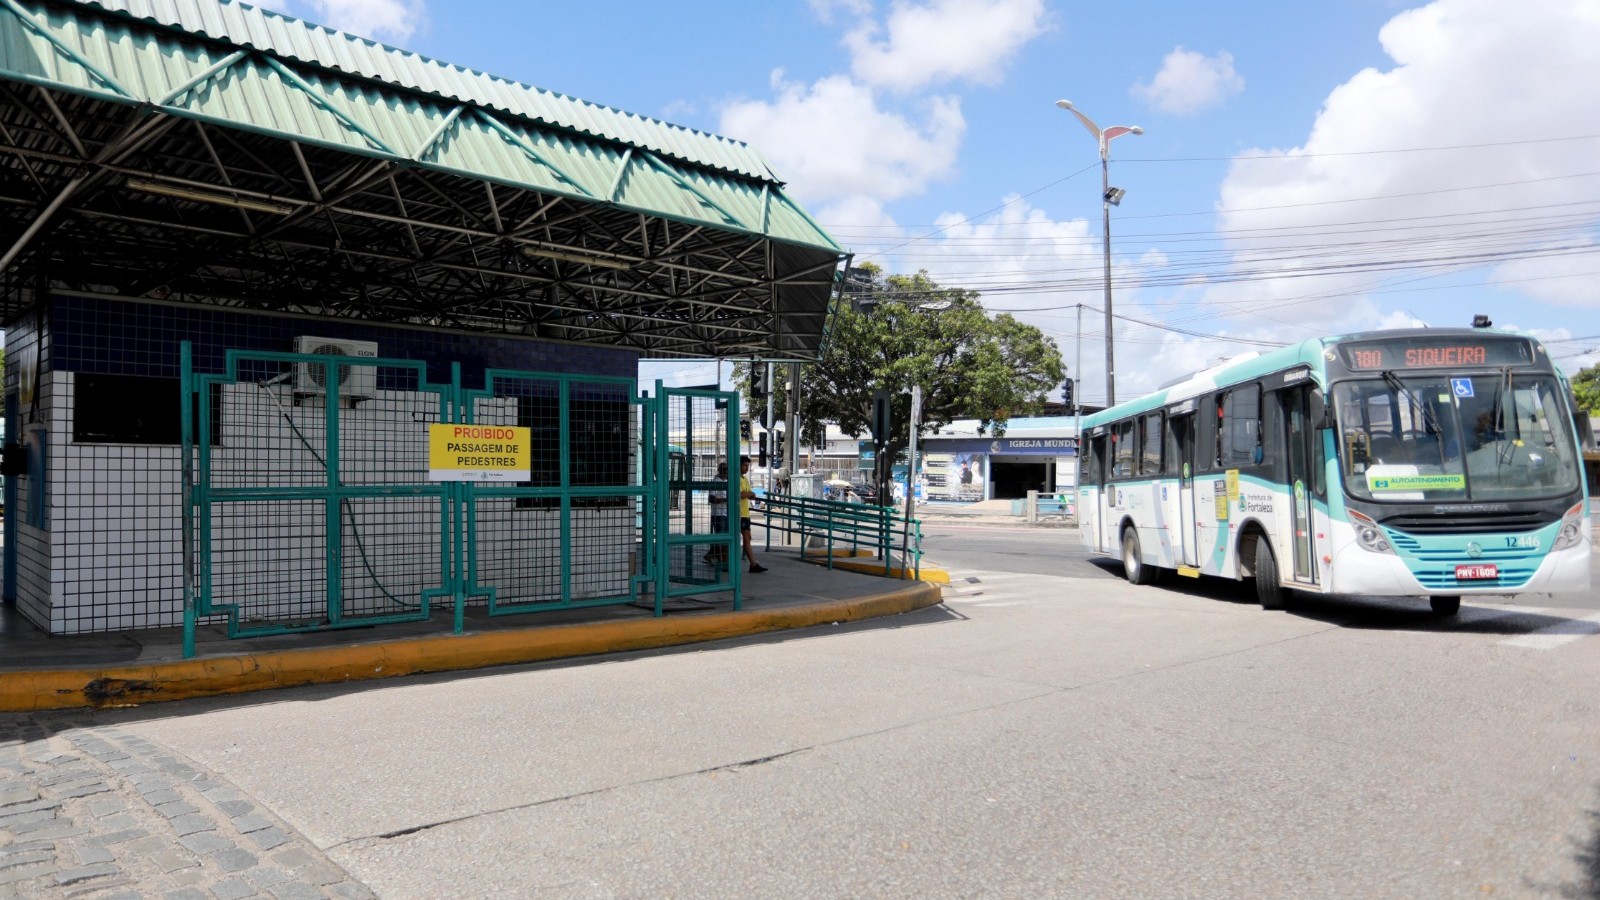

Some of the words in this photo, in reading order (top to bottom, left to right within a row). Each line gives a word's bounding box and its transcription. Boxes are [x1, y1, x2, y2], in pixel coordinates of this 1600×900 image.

[1405, 347, 1486, 367] SIQUEIRA
[454, 427, 514, 440] PROIBIDO
[447, 443, 503, 453] PASSAGEM
[505, 444, 519, 454] DE
[1044, 440, 1077, 448] MUNDI
[457, 457, 516, 467] PEDESTRES
[1390, 476, 1460, 484] AUTOATENDIMENTO
[1247, 501, 1273, 513] Fortaleza
[1504, 535, 1540, 548] 12446
